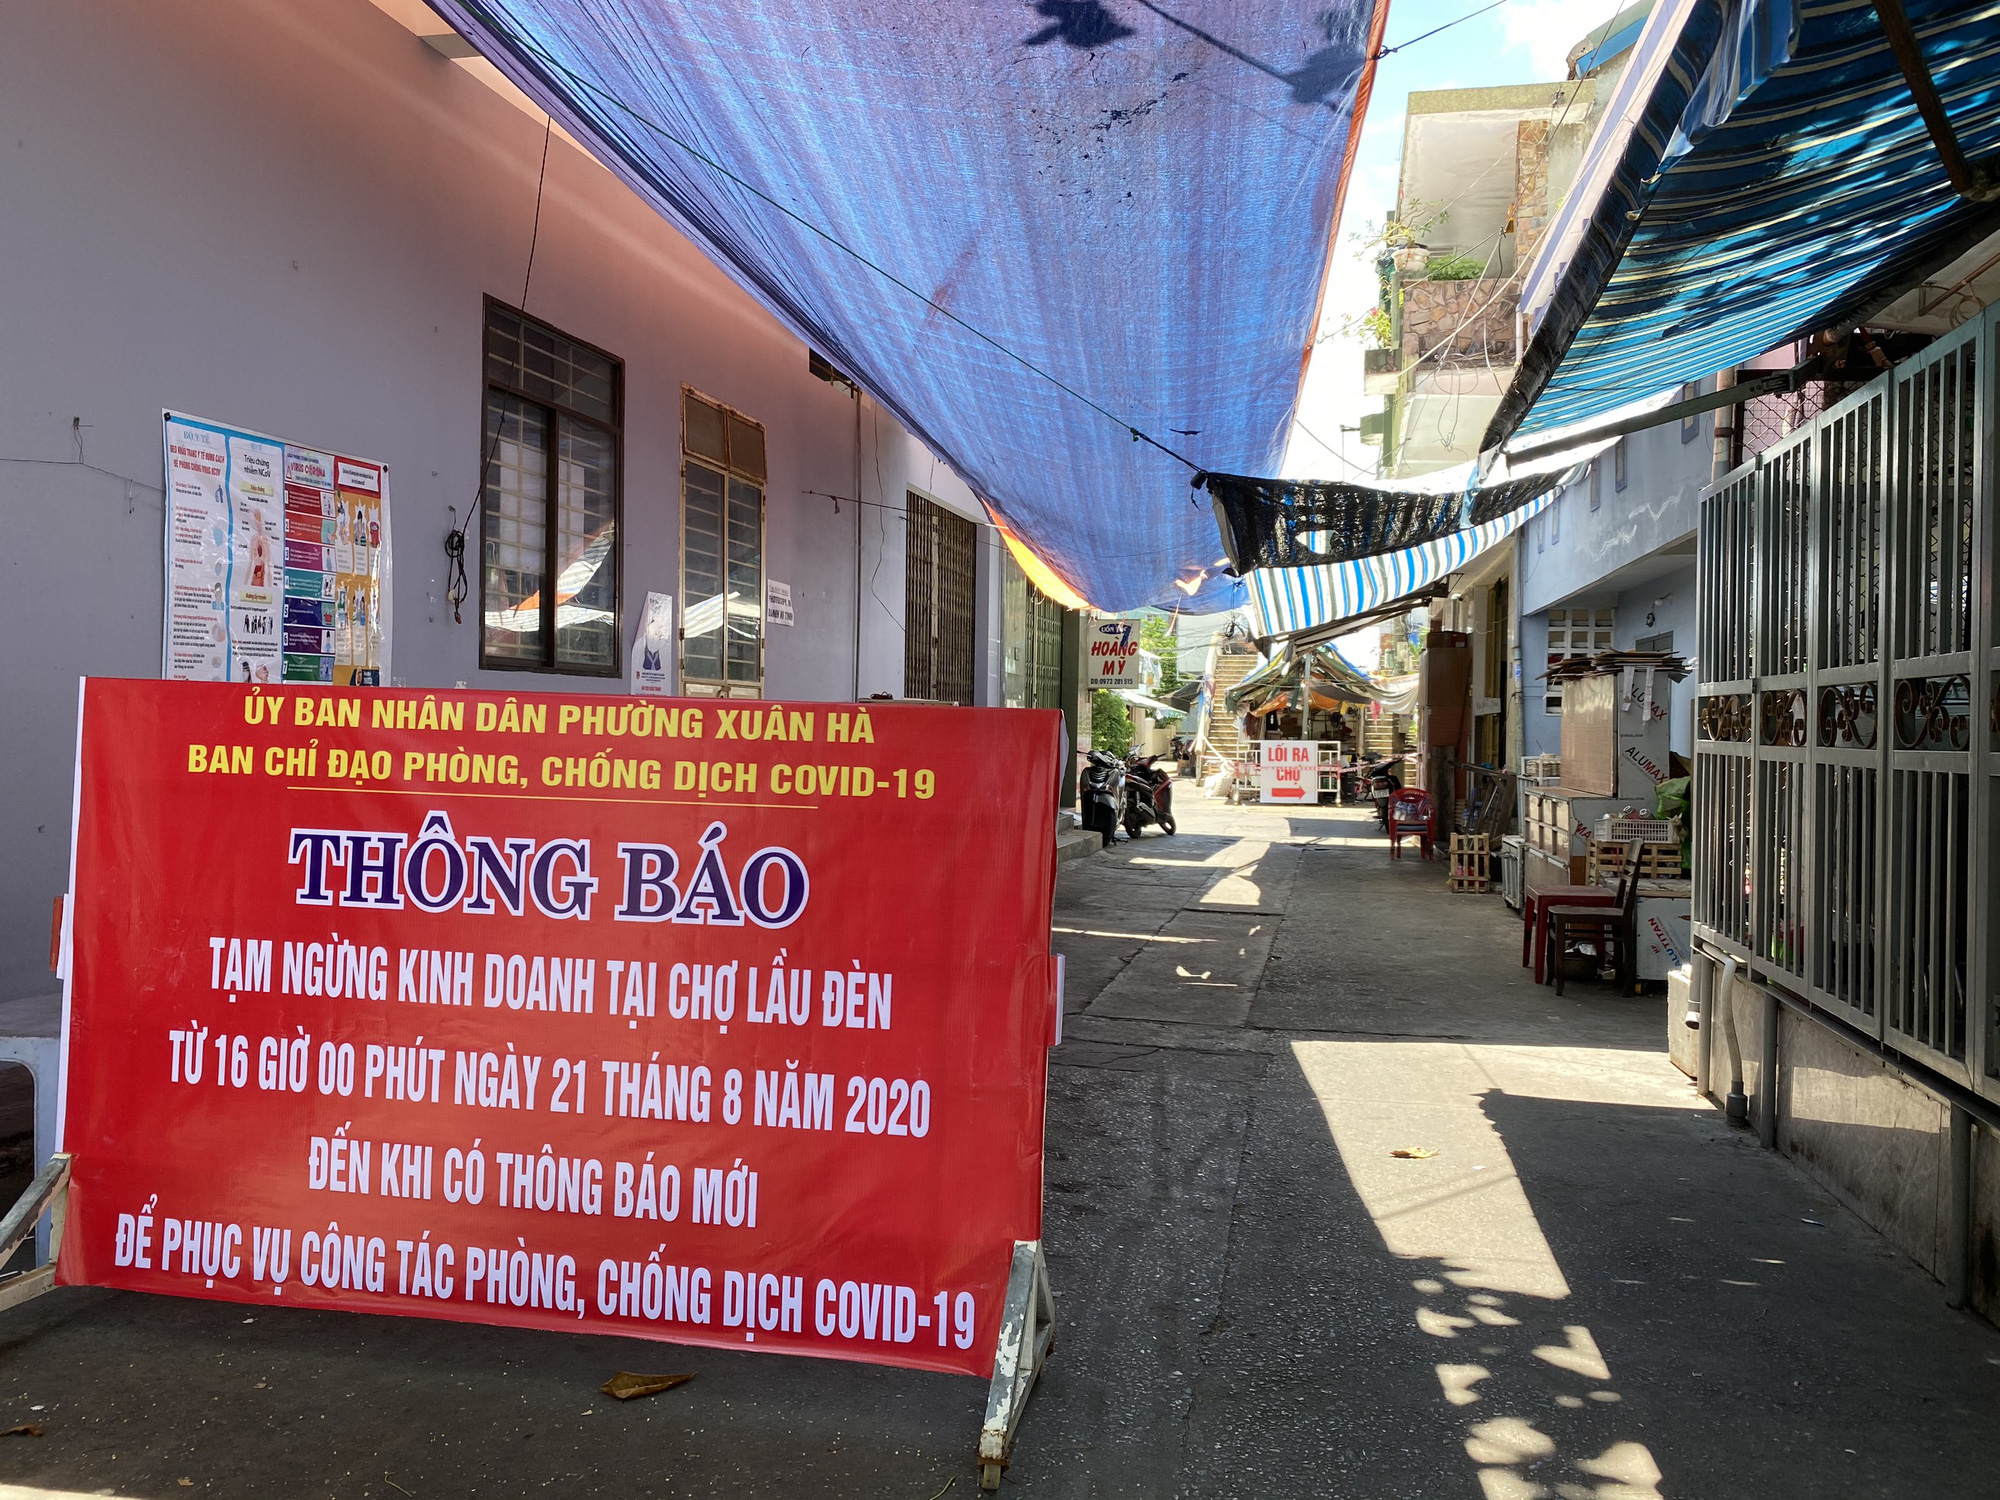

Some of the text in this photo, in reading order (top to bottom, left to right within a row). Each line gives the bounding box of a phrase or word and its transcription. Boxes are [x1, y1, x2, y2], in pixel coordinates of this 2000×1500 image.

[1091, 636, 1138, 656] HOÀNG
[1102, 656, 1126, 675] MỸ
[244, 686, 875, 744] ỦY BAN NHÂN DÂN PHƯỜNG XUÂN HÀ
[1632, 683, 1668, 720] LUAX
[187, 739, 936, 800] BAN CHỈ ĐẠO PHÒNG, CHỐNG DỊCH COVID-19
[1268, 743, 1309, 762] LỐI RA
[1625, 746, 1669, 784] ALUMAX
[287, 809, 810, 930] THÔNG BÁO
[1648, 917, 1683, 967] ALUTITAN
[209, 932, 893, 1035] TẠM NGỪNG KINH DOANH TẠI CHỢ LẦU ĐÈN
[168, 1019, 932, 1139] TỪ 16 GIỜ 00 PHÚT NGÀY 21 THÁNG 8 NĂM 2020
[308, 1120, 759, 1229] ĐẾN KHI CÓ THÔNG BÁO MỚI
[114, 1193, 976, 1351] ĐỂ PHỤC VỤ CÔNG TÁC PHÒNG, CHỐNG DỊCH COVID-19
